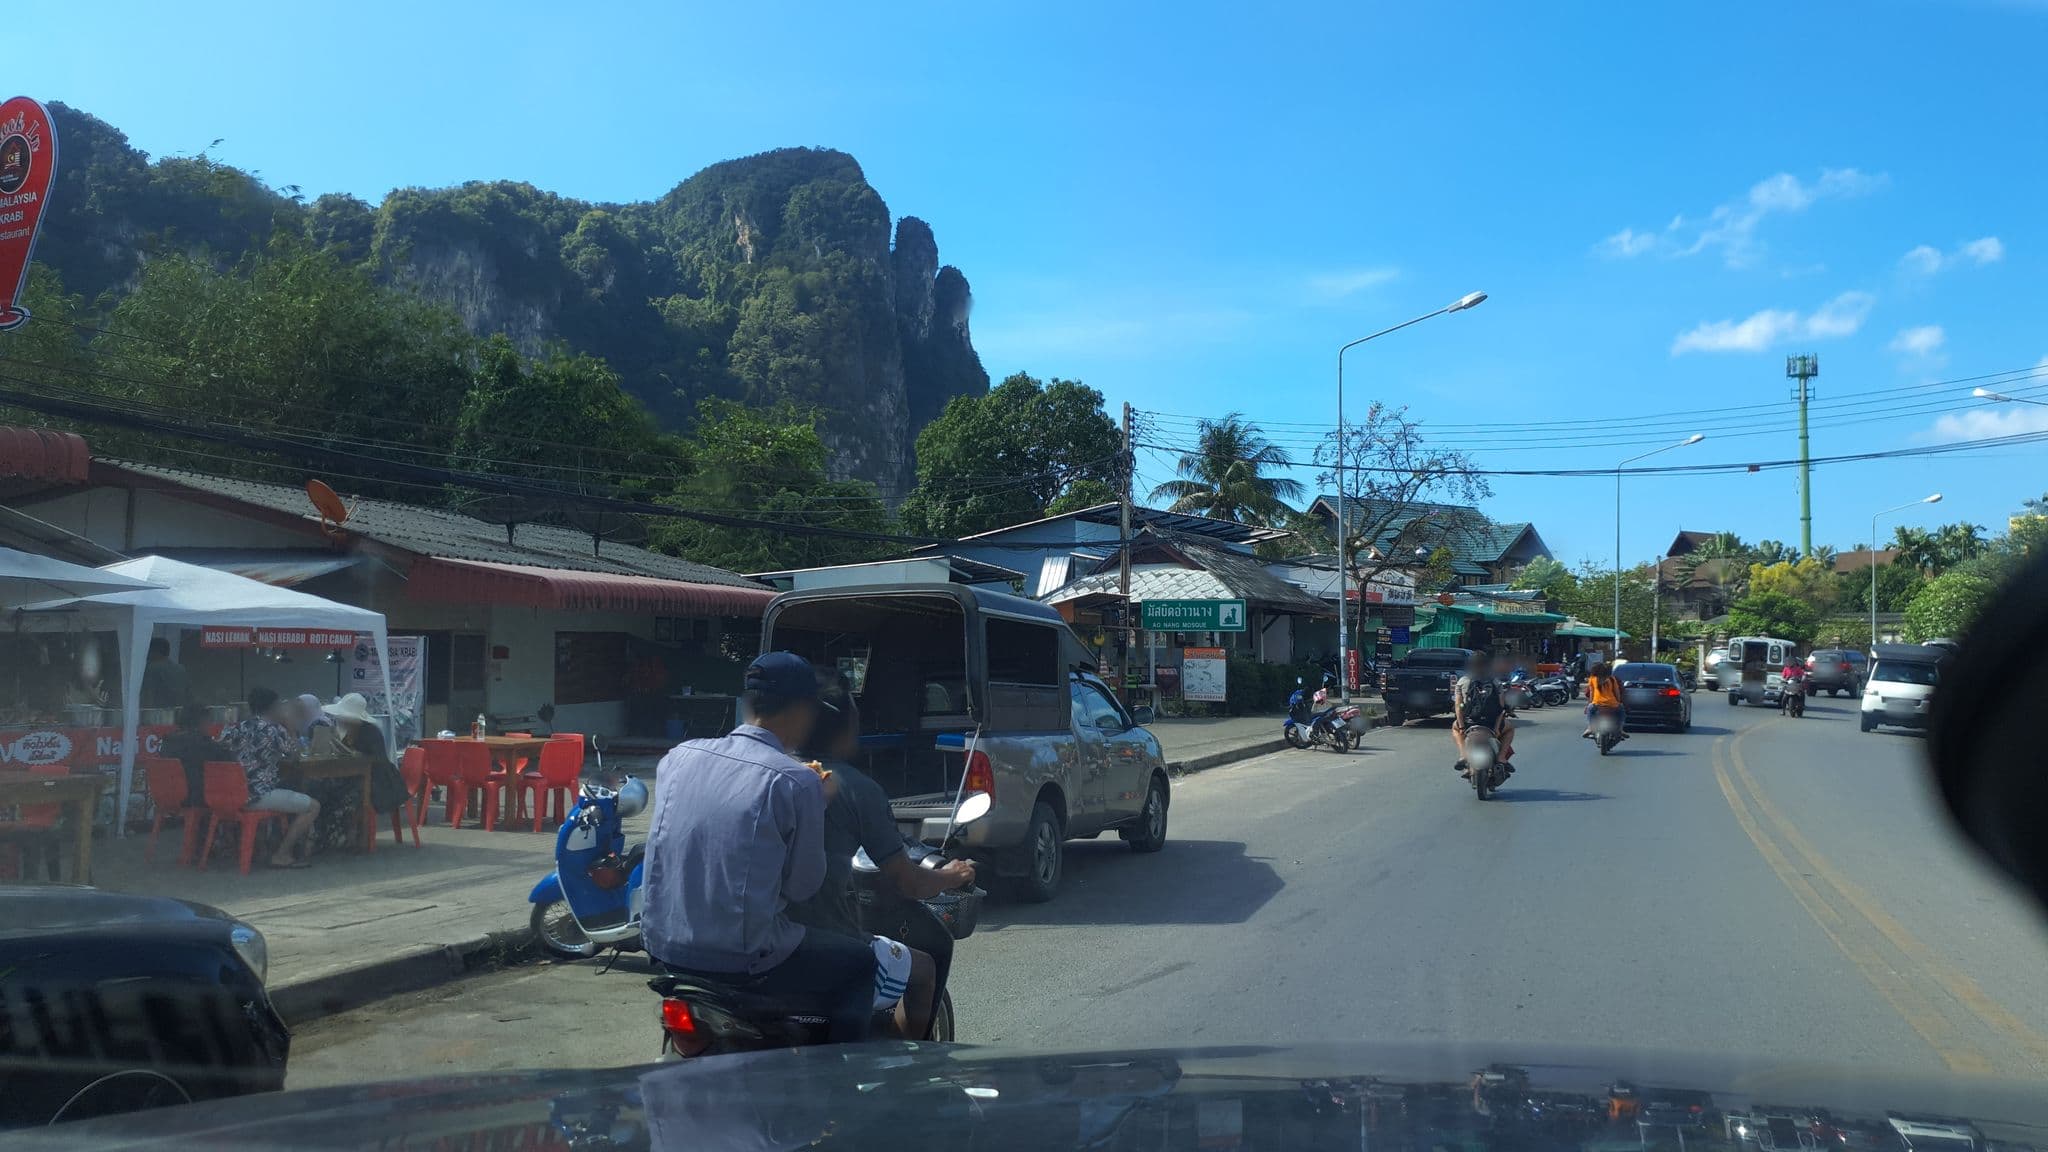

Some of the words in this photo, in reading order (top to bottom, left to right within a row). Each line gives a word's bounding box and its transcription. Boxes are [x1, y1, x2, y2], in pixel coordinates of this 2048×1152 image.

[0, 226, 30, 240] staurant
[205, 631, 224, 643] NASI
[225, 631, 250, 643] LEMAK
[259, 631, 276, 643] NASI
[309, 633, 328, 644] ROTI
[1348, 649, 1357, 690] TATTOO
